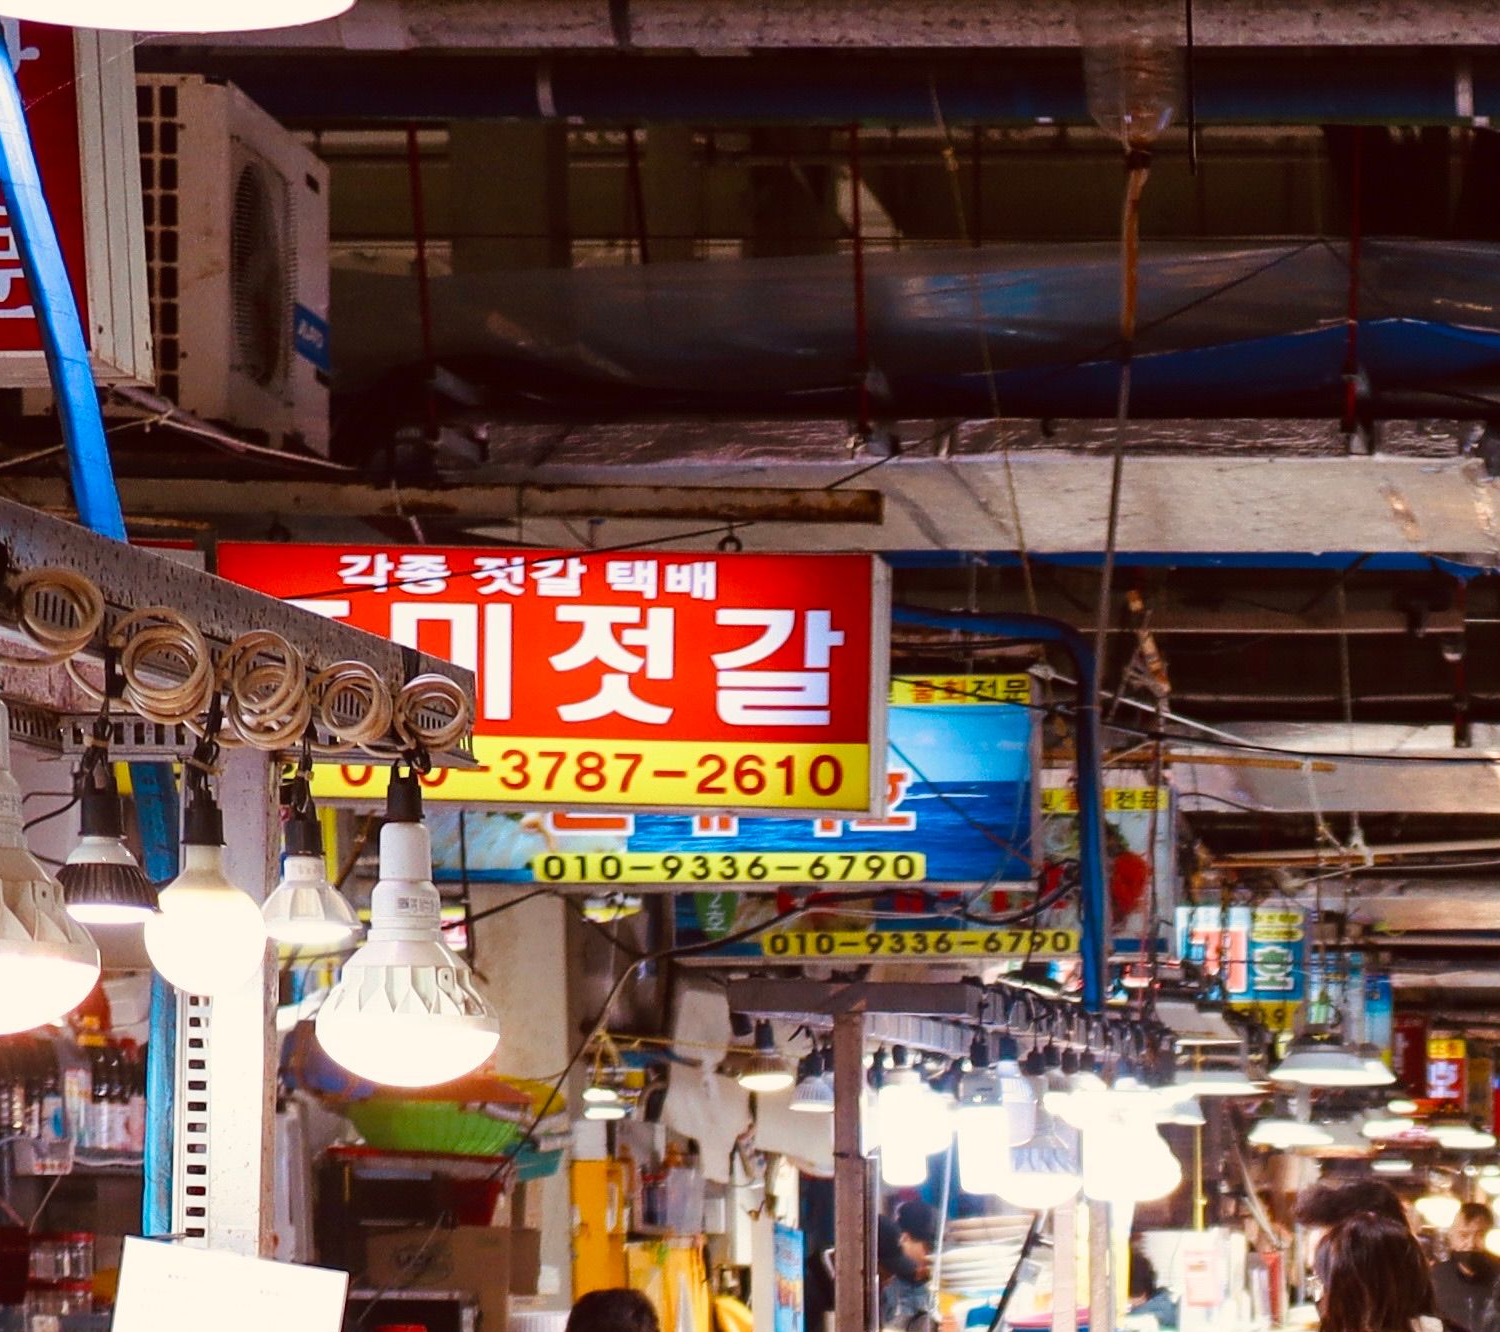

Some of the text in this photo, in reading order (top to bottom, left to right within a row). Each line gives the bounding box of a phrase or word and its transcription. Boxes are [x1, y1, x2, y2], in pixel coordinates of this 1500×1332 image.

[337, 552, 717, 602] 각종 젓갈 택배
[298, 600, 845, 727] 미젓갈
[542, 852, 917, 881] 010-9336-6790
[768, 931, 1073, 957] 010-9336-6790
